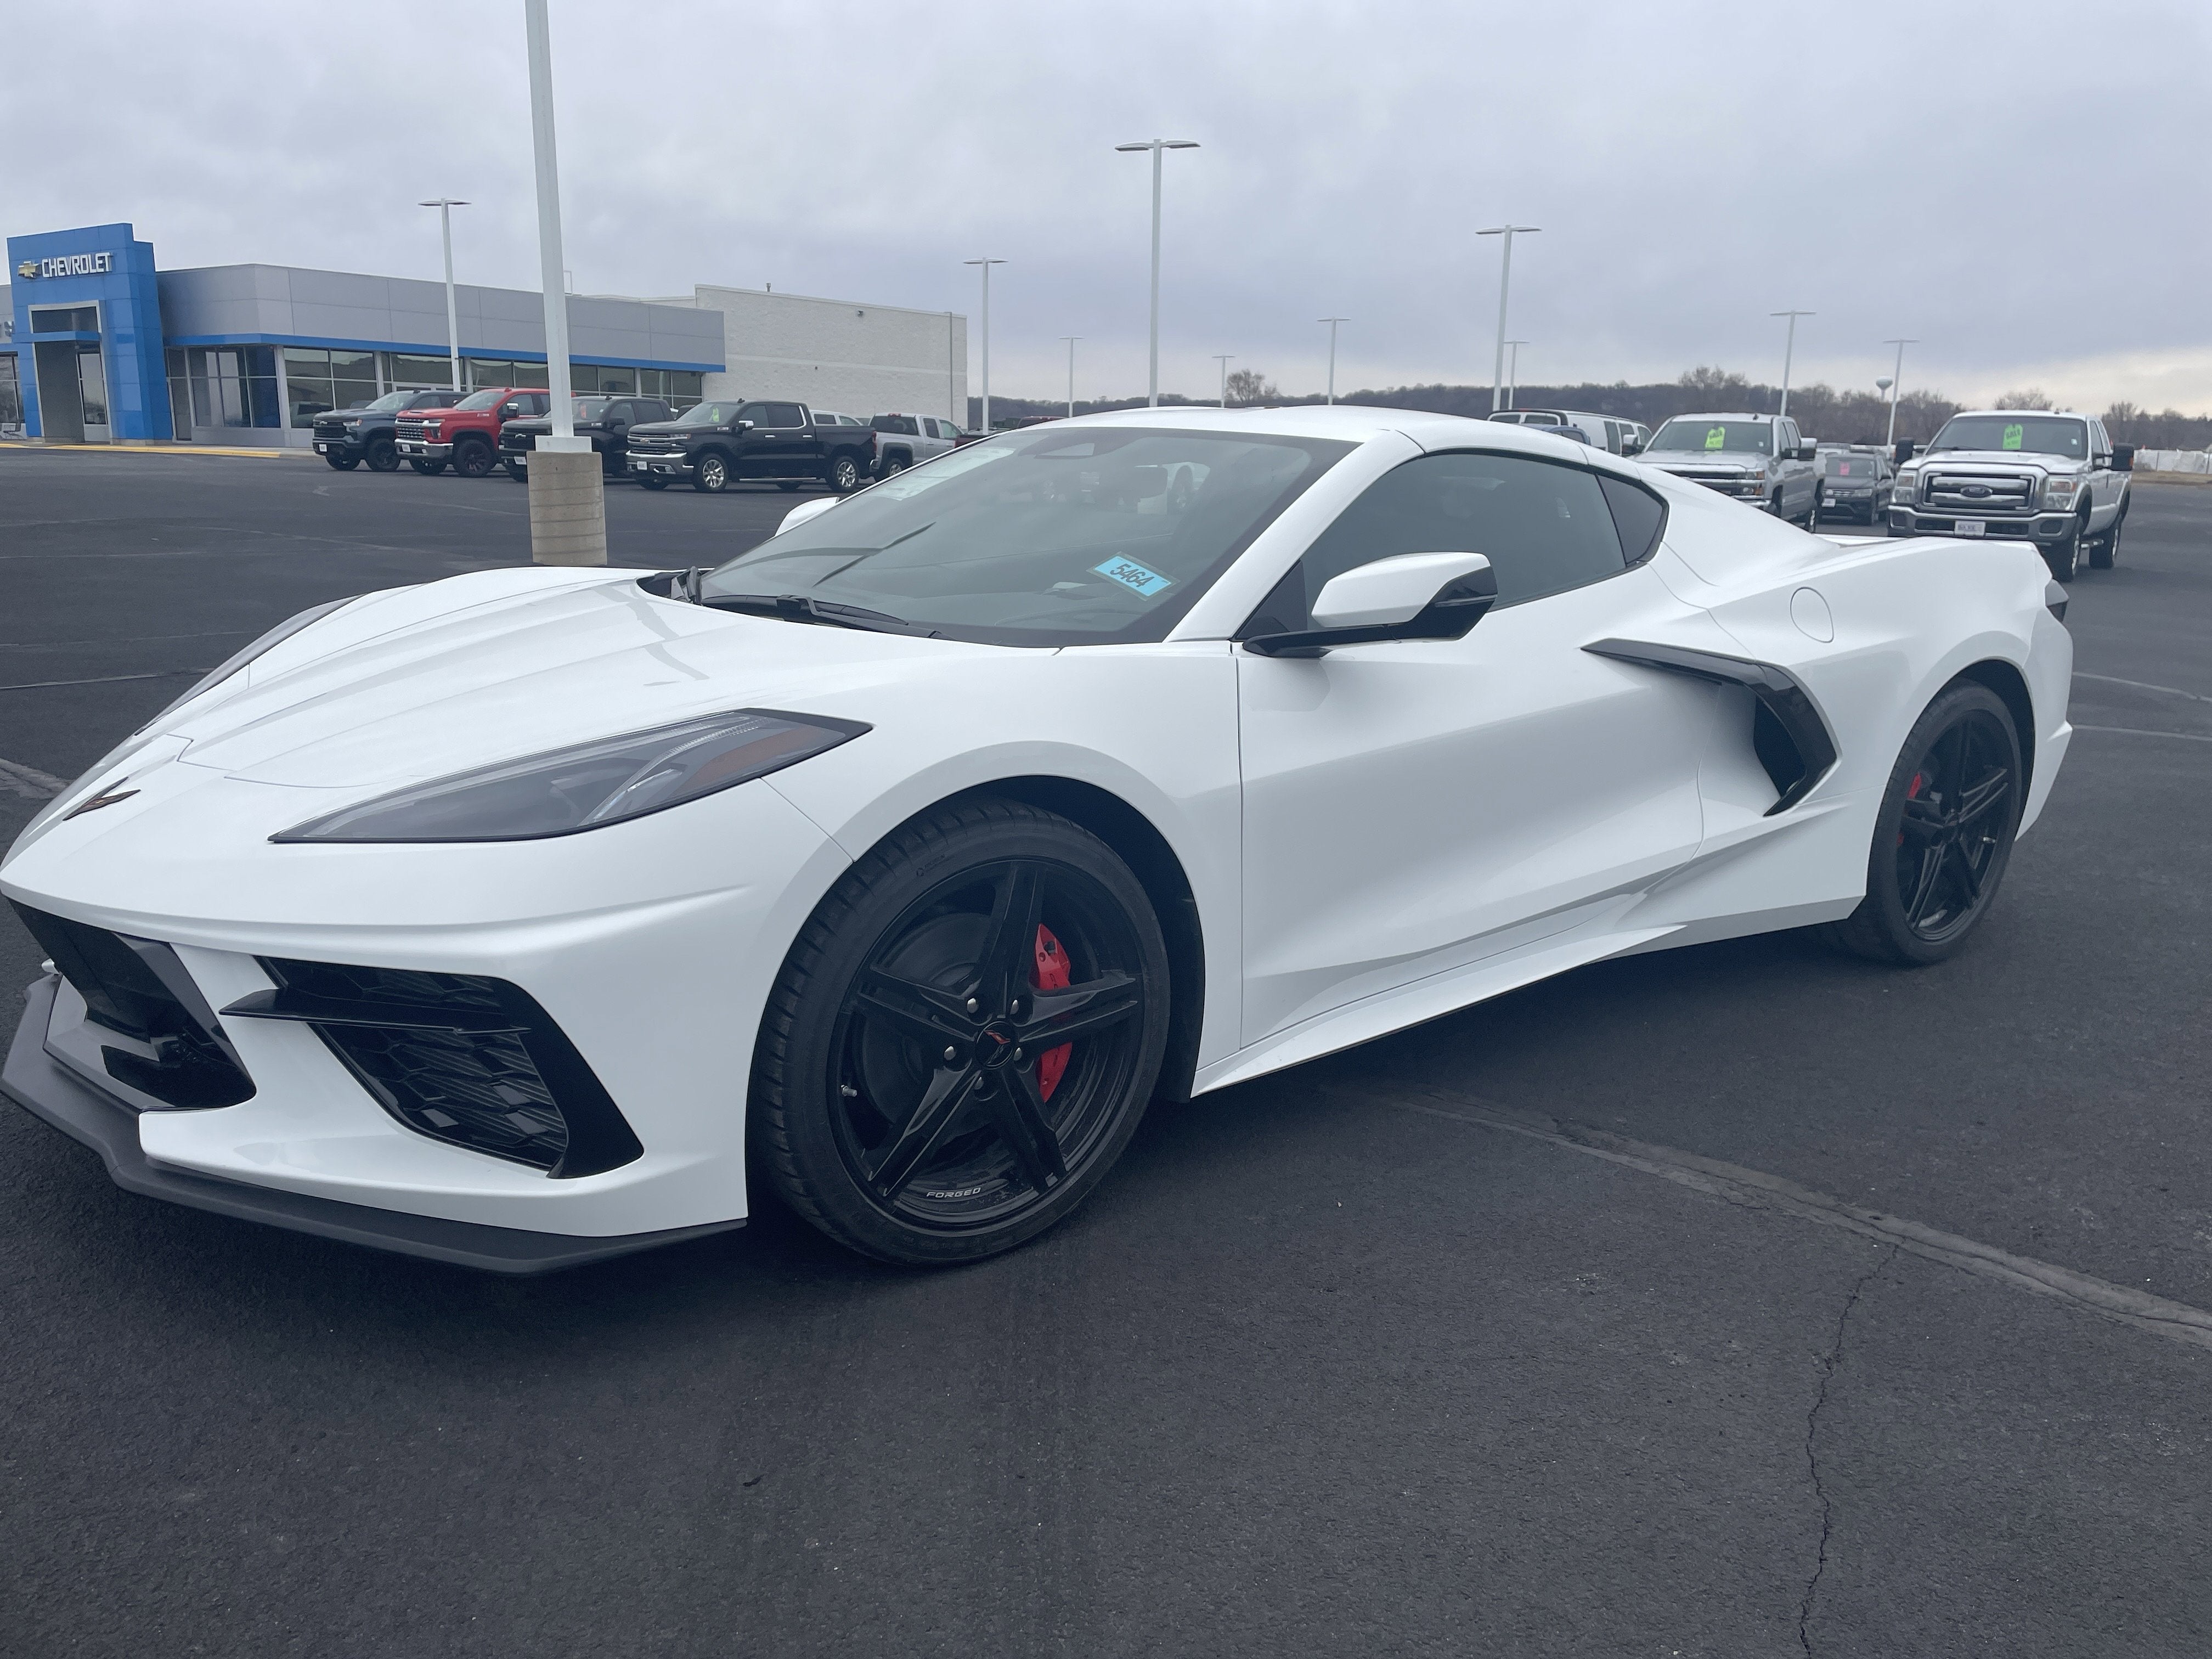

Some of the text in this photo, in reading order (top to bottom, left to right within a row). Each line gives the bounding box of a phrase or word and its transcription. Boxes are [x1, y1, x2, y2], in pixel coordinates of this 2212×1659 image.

[42, 252, 110, 278] CHEVROLET
[1109, 563, 1155, 588] 5464
[926, 1187, 981, 1198] FORGED
